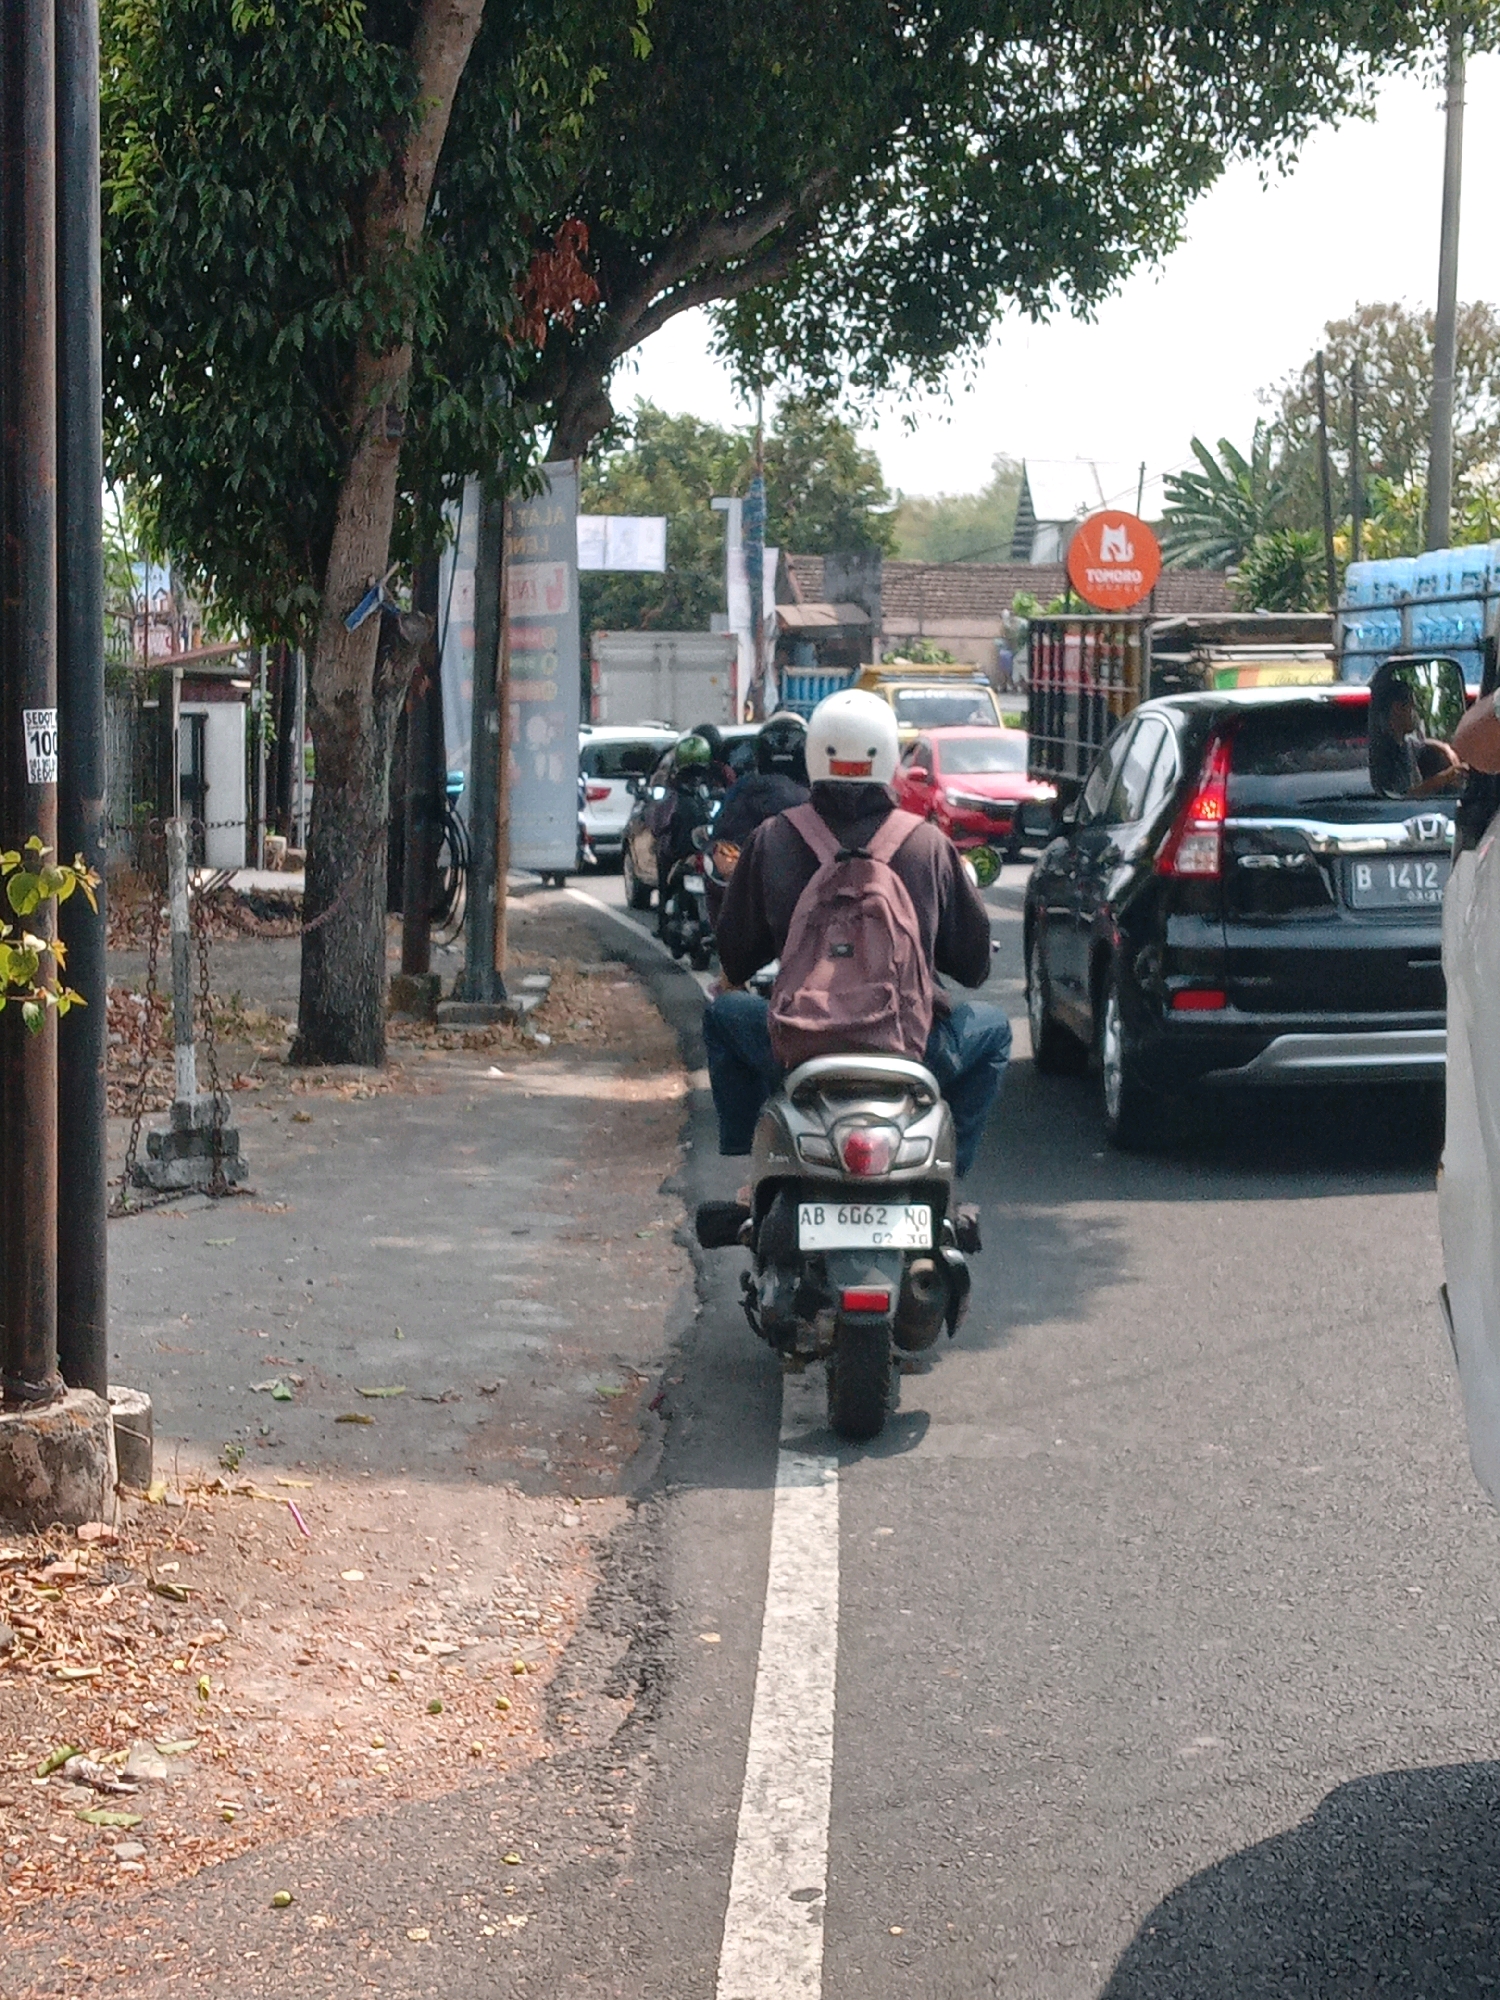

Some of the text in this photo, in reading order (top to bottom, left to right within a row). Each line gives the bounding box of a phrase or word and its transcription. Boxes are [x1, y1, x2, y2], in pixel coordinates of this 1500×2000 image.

[1085, 567, 1143, 585] TOMORO
[26, 711, 53, 725] SEDOT
[1356, 861, 1439, 890] B 1412
[801, 1207, 825, 1225] AB
